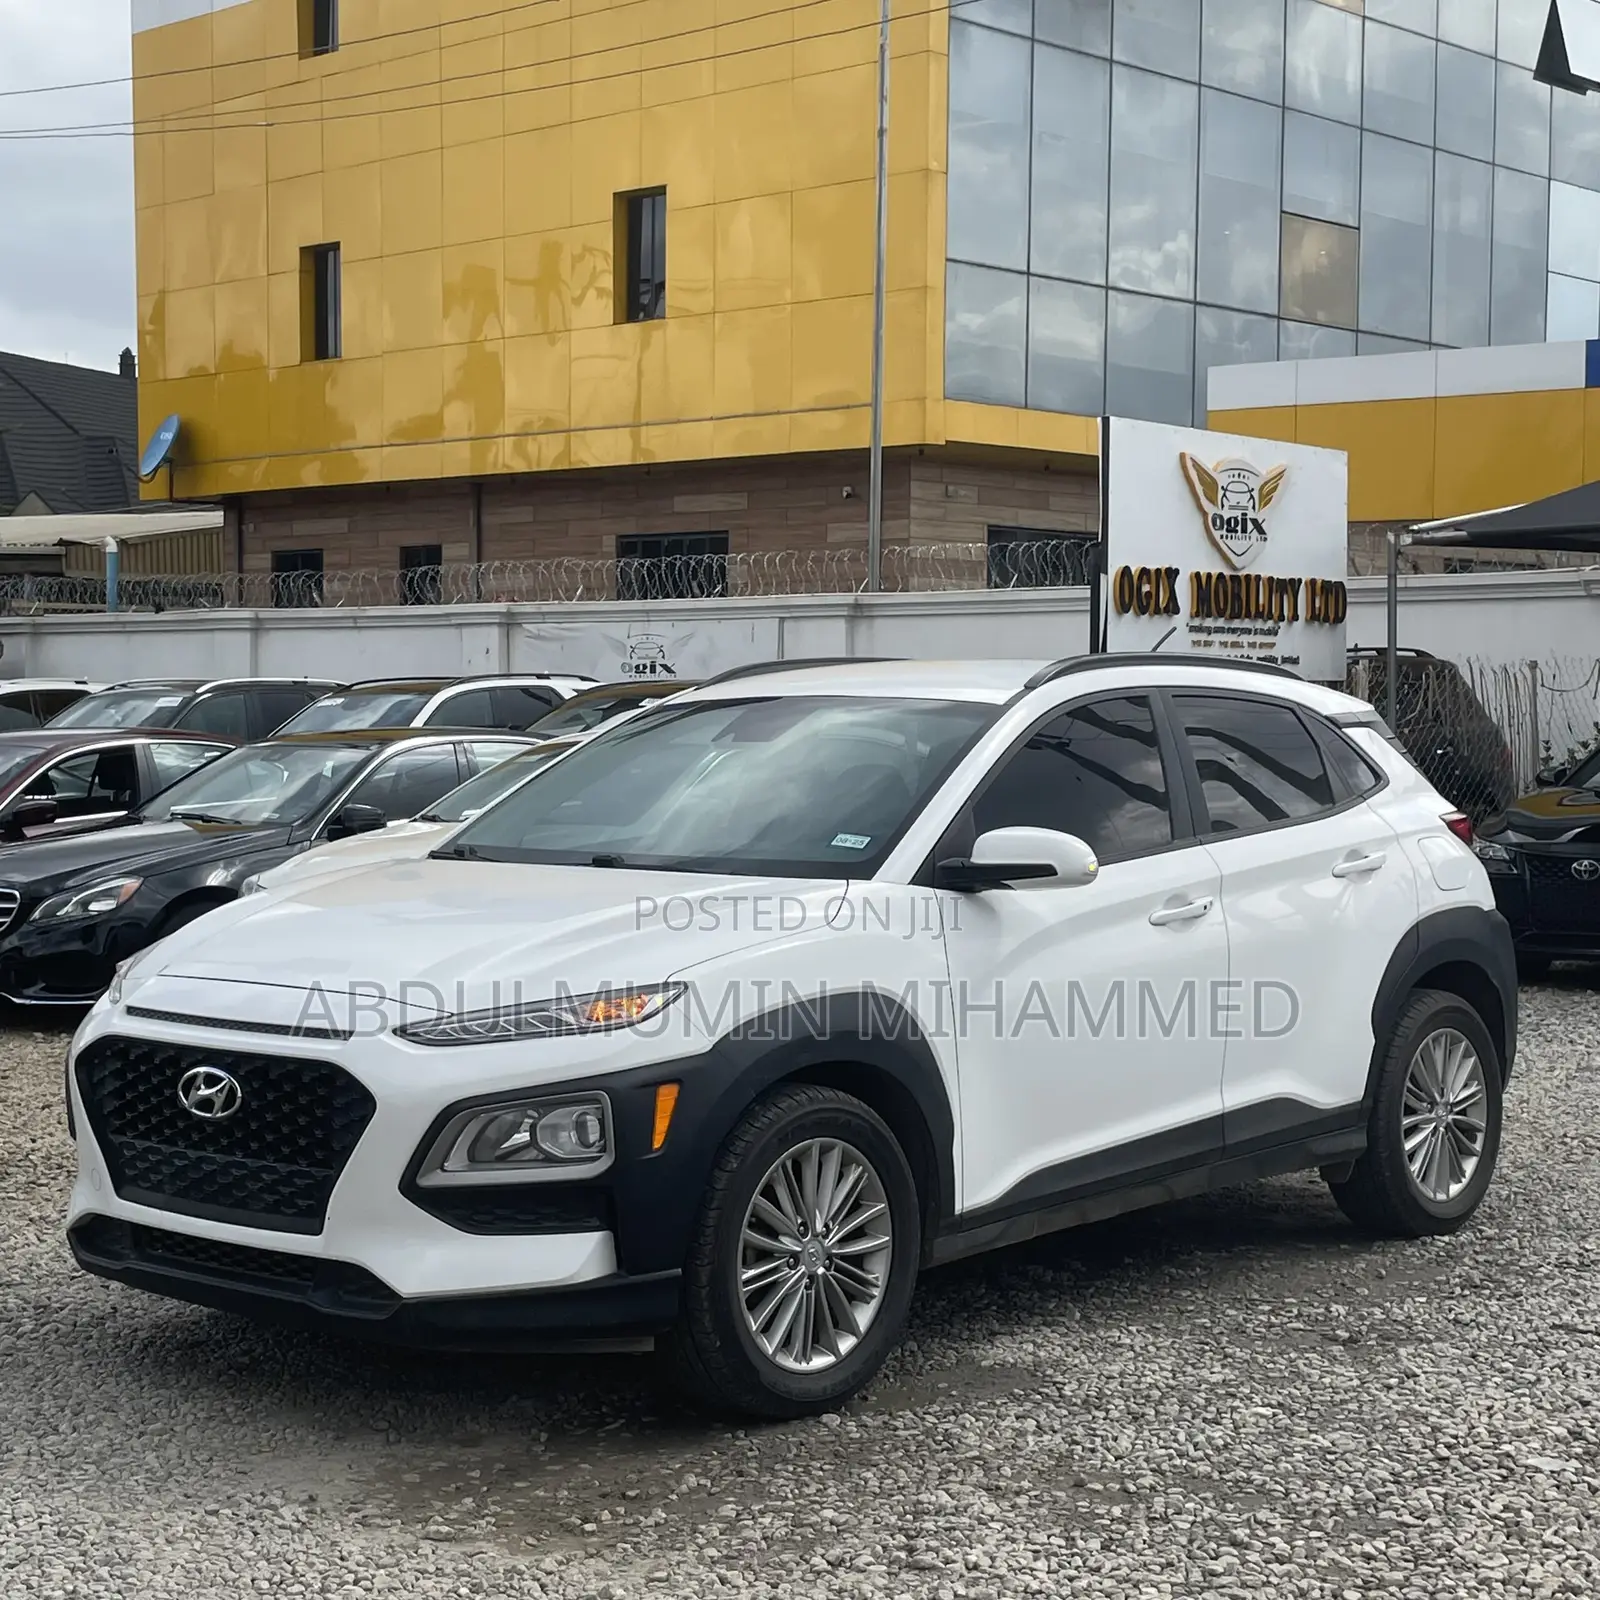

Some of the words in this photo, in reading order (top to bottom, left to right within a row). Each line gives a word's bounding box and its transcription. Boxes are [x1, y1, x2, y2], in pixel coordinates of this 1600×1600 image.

[1114, 565, 1180, 616] OGIX
[1190, 571, 1302, 622] MOBILITY
[1305, 577, 1348, 624] LTD
